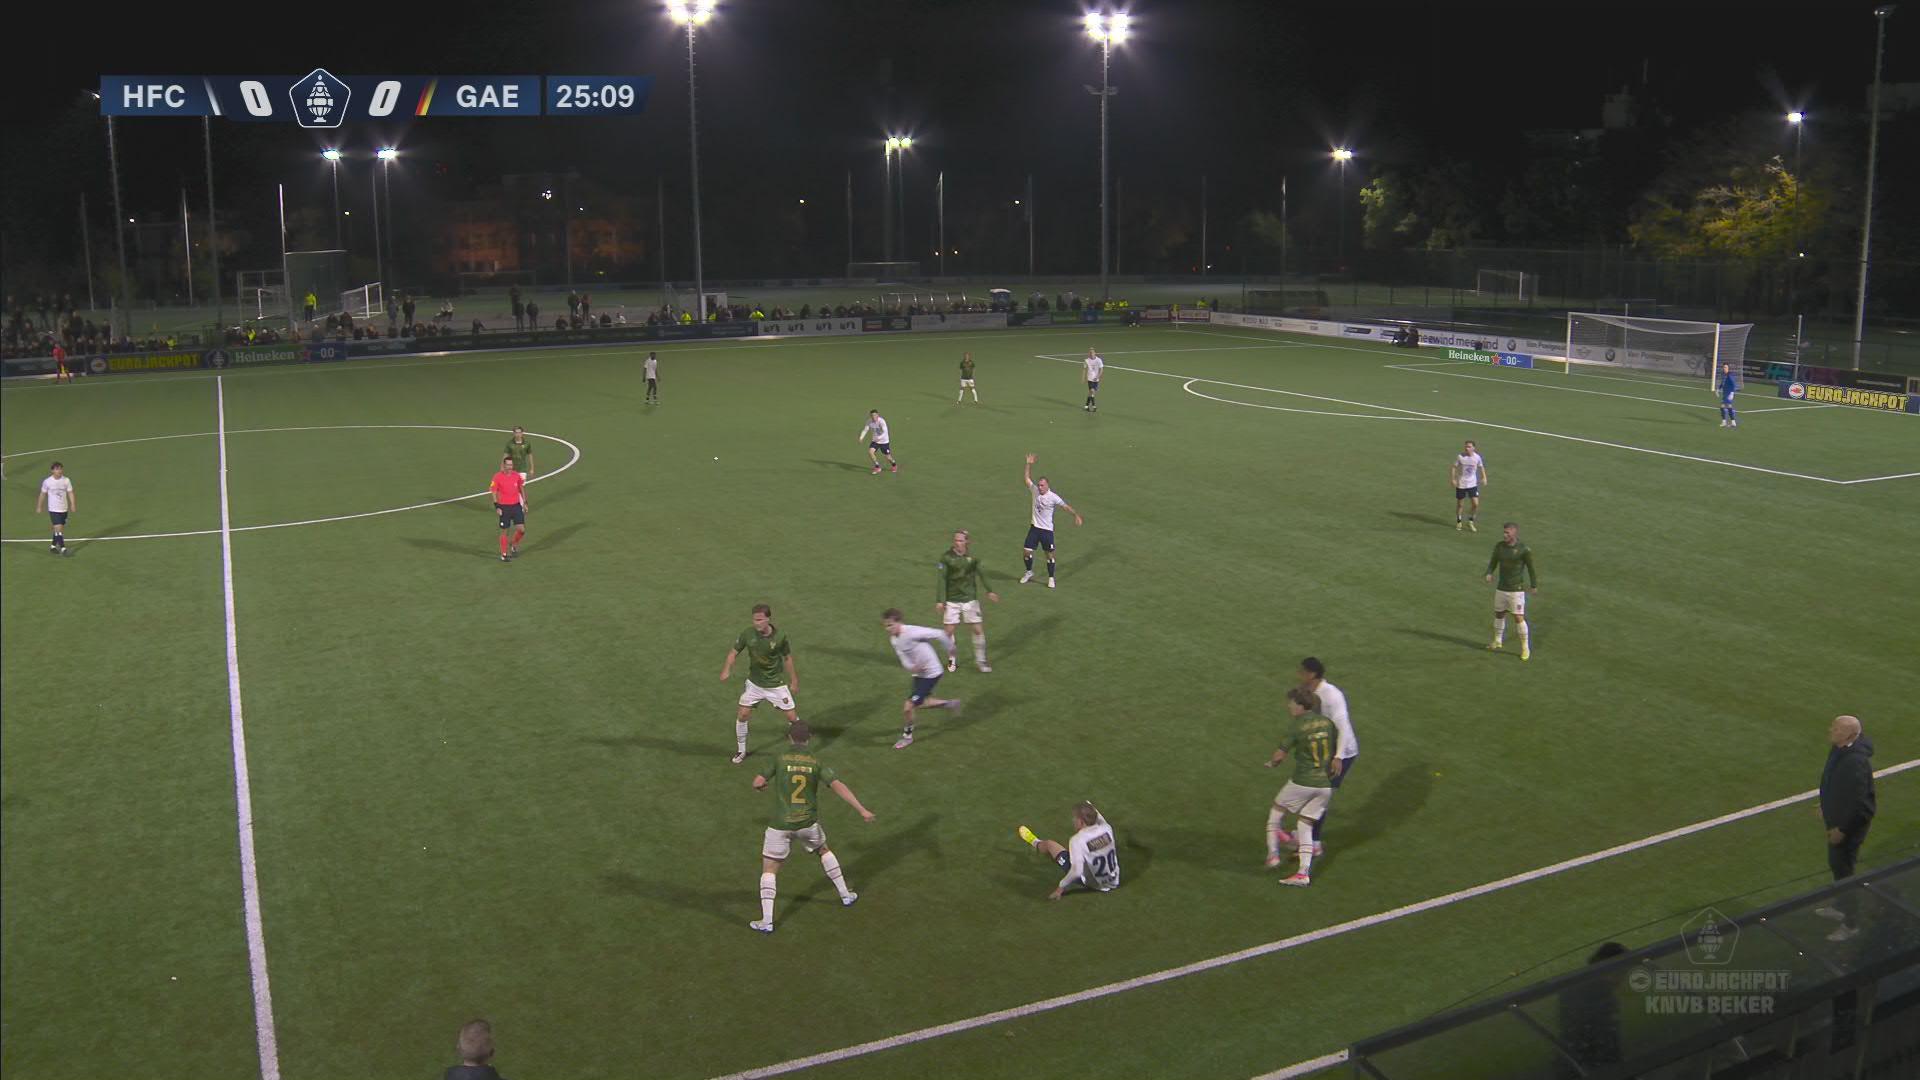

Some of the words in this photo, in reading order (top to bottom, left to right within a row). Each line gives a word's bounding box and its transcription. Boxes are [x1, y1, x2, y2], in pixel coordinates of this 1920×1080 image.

[235, 350, 295, 364] Heineken
[1448, 349, 1490, 363] Heineken
[1806, 384, 1908, 412] EUROJACKPOT
[1311, 738, 1329, 768] 11
[791, 774, 807, 804] 2
[1092, 848, 1117, 878] 20
